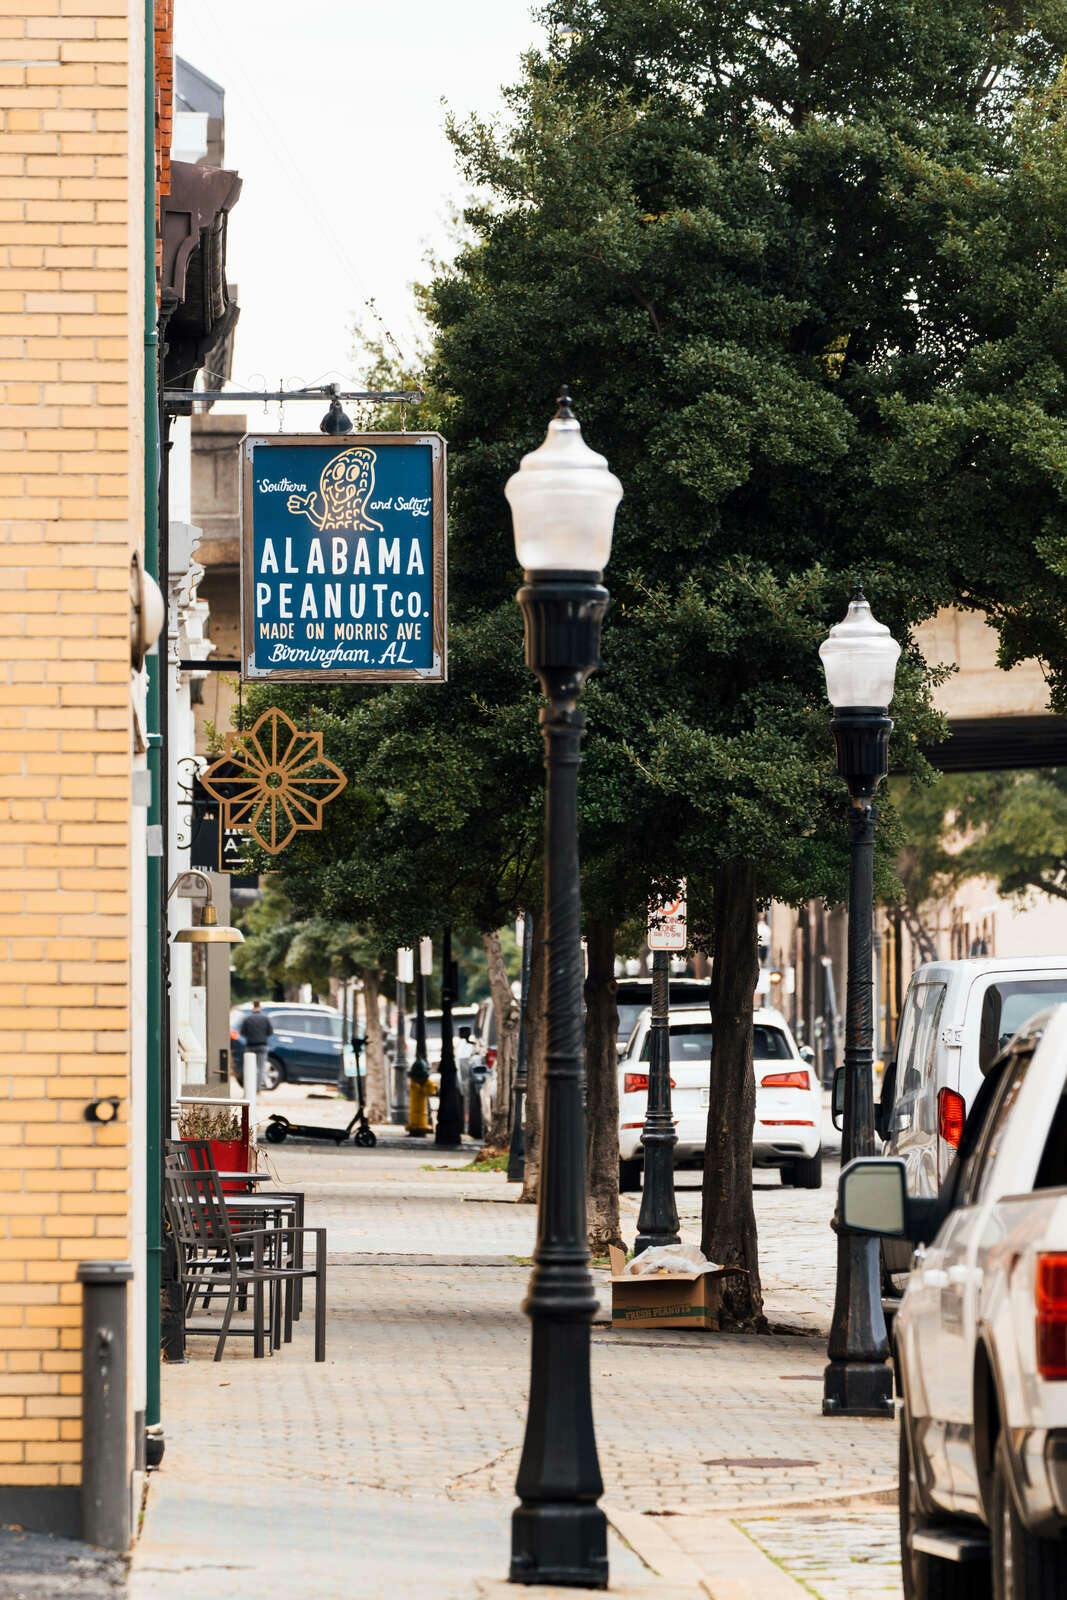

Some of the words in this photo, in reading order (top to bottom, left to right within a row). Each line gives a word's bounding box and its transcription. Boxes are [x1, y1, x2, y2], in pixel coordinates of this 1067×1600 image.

[370, 498, 391, 510] and
[260, 537, 424, 575] ALABAMA
[256, 582, 388, 619] PEANUT
[259, 622, 295, 640] MADE
[306, 622, 325, 640] ON
[334, 622, 388, 640] MORRIS
[396, 622, 421, 640] AVE
[268, 642, 377, 668] Birmingham,
[379, 641, 413, 665] AL
